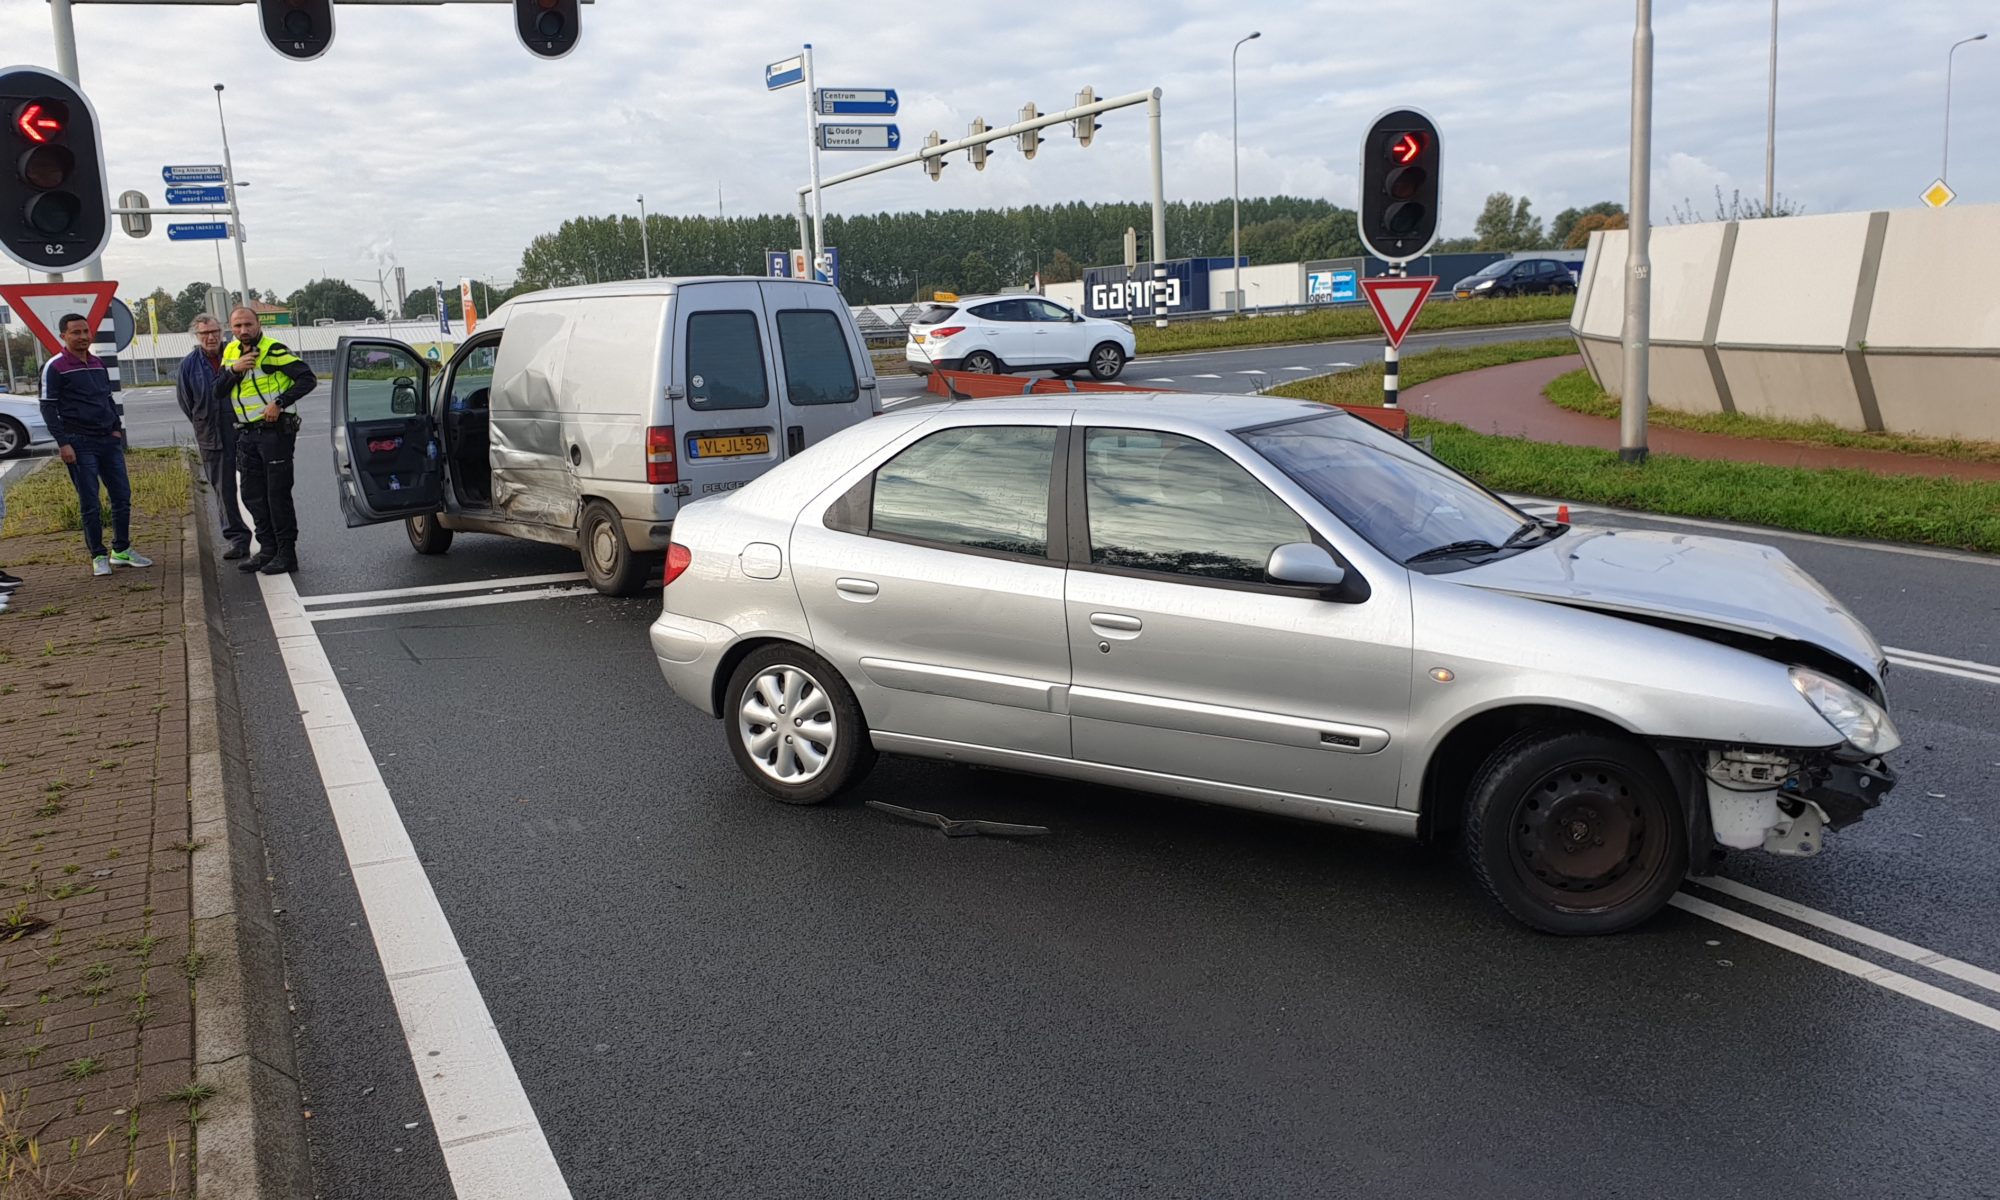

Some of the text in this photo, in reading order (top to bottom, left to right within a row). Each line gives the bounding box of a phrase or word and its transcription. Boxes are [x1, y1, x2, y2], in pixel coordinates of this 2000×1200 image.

[45, 244, 65, 255] 6.2
[1395, 240, 1402, 248] 4
[1309, 275, 1319, 294] 7
[1310, 293, 1332, 303] open
[702, 480, 748, 493] PEUGE
